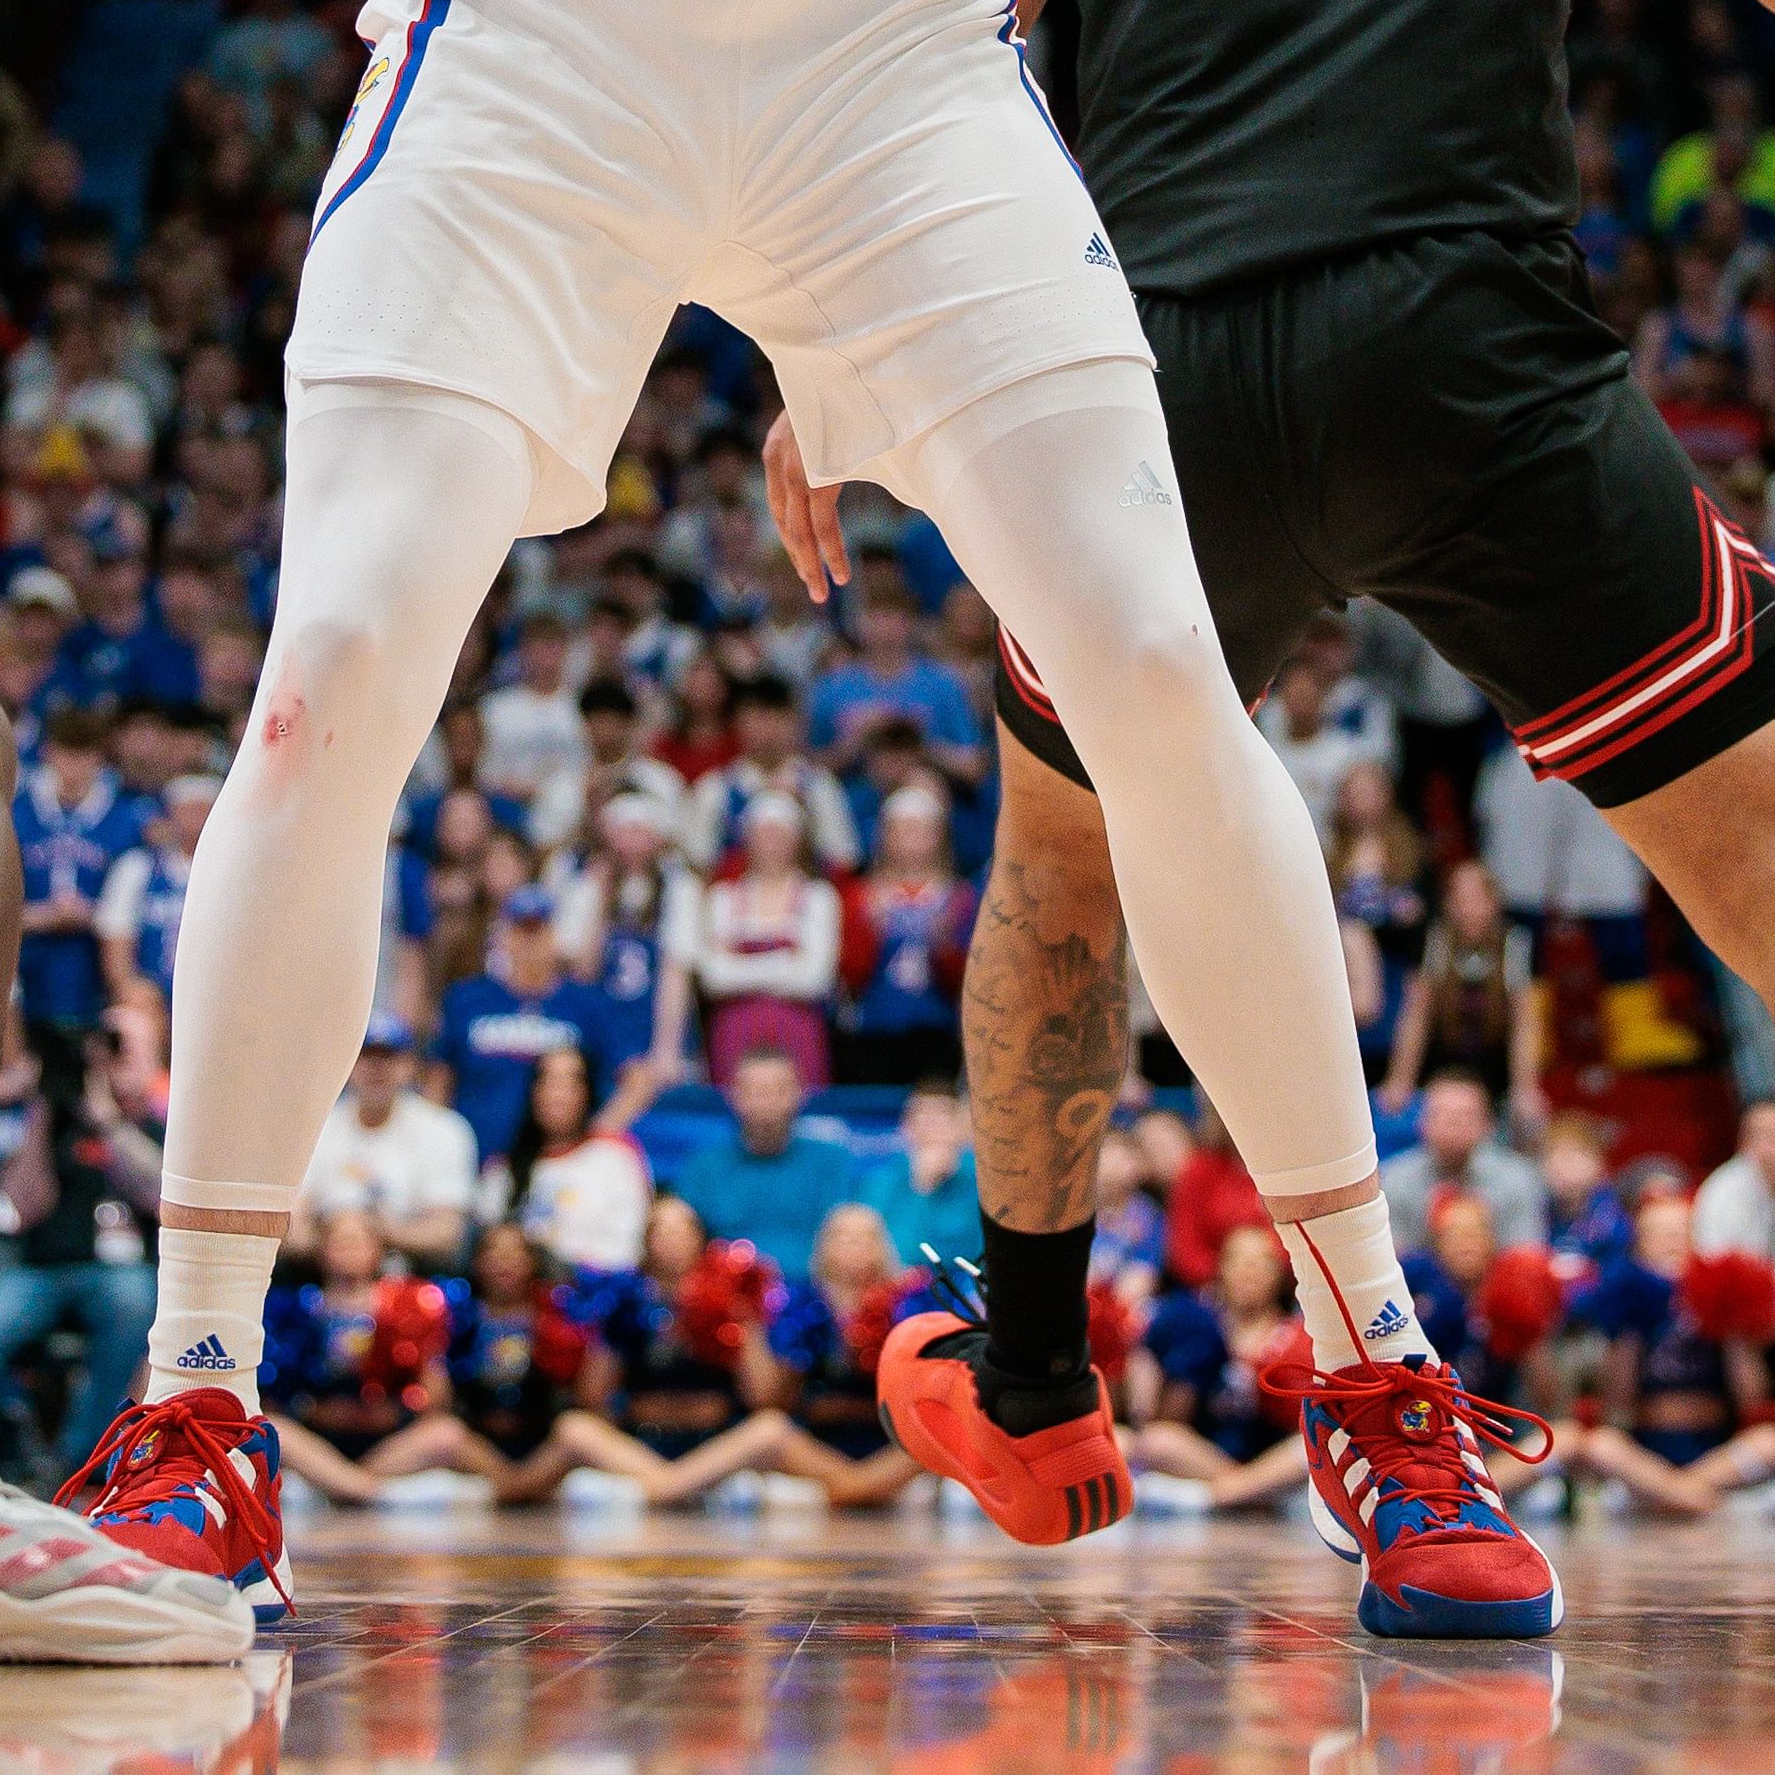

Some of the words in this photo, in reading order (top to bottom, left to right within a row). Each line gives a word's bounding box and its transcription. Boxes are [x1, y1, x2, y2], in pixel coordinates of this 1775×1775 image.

[1118, 484, 1173, 509] adidas
[1363, 1314, 1409, 1340] adidas
[176, 1353, 236, 1370] adidas
